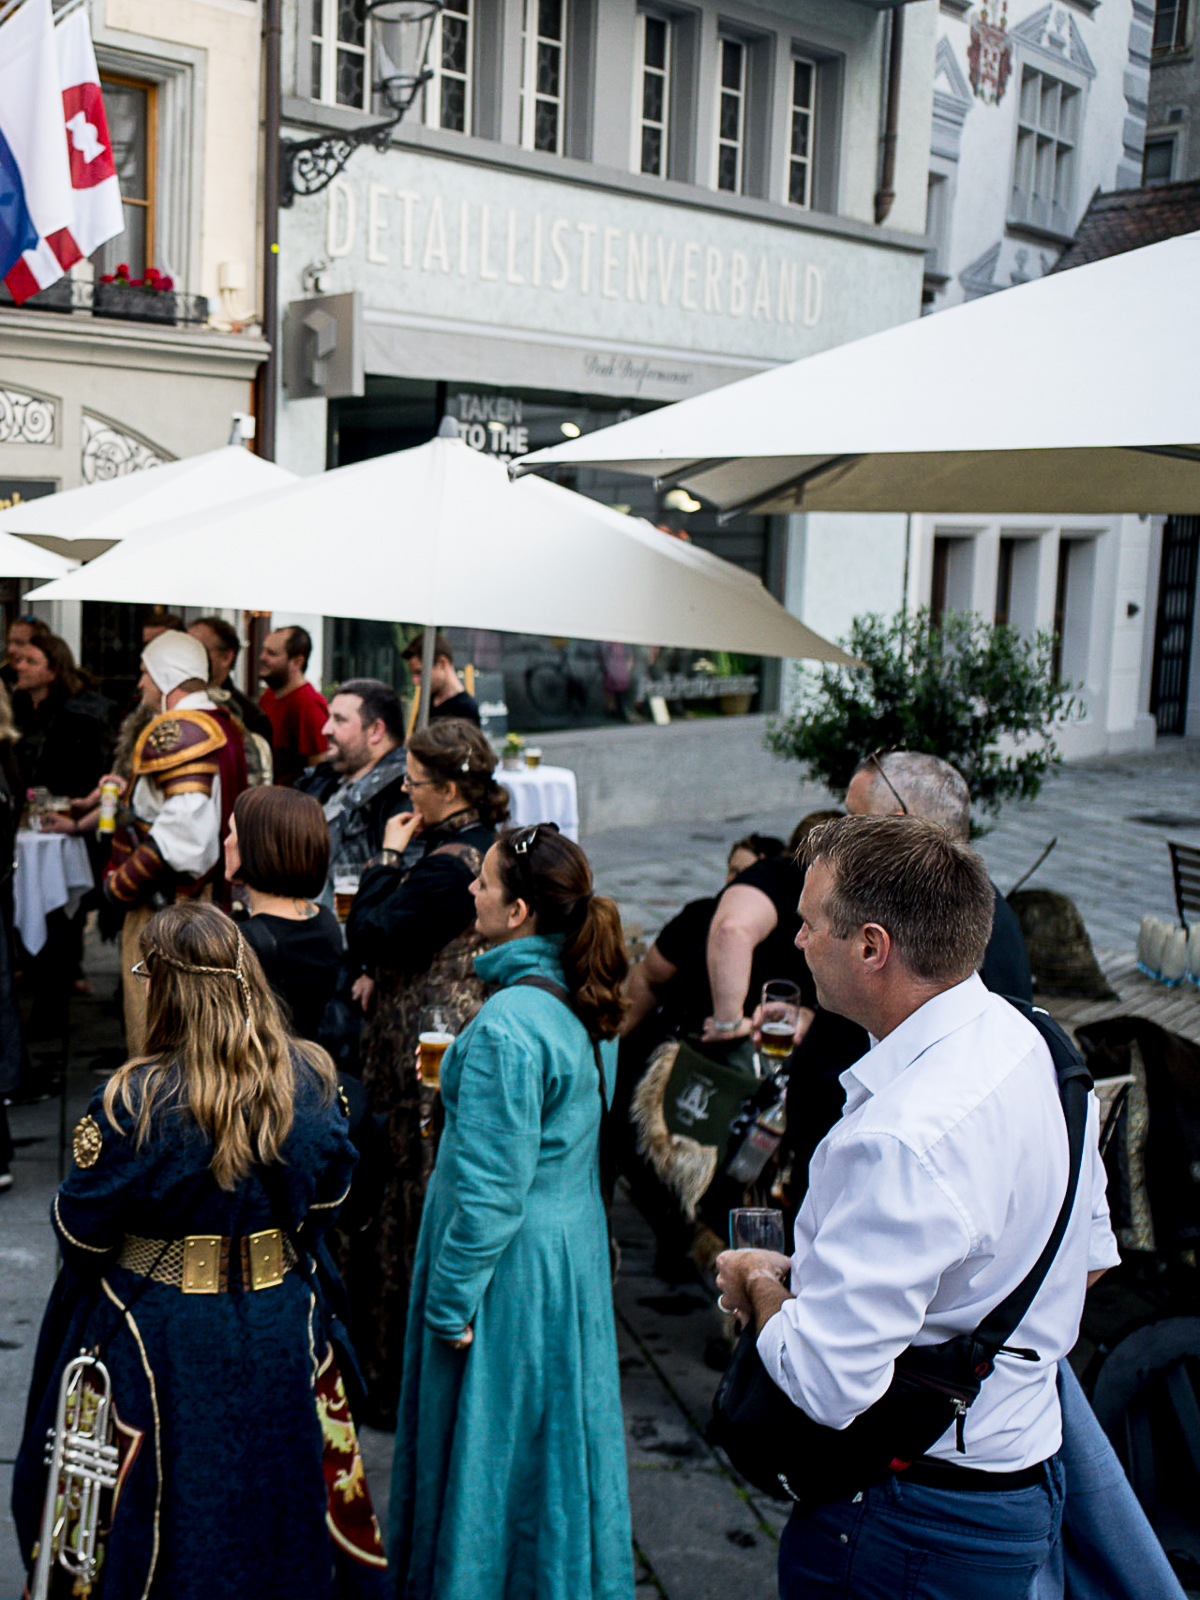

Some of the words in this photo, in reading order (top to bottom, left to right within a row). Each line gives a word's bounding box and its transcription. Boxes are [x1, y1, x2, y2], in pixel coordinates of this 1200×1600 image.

[327, 177, 823, 328] DETAILLISTENVERBAND
[458, 393, 523, 423] TAKEN
[458, 422, 486, 450] TO
[489, 425, 529, 454] THE
